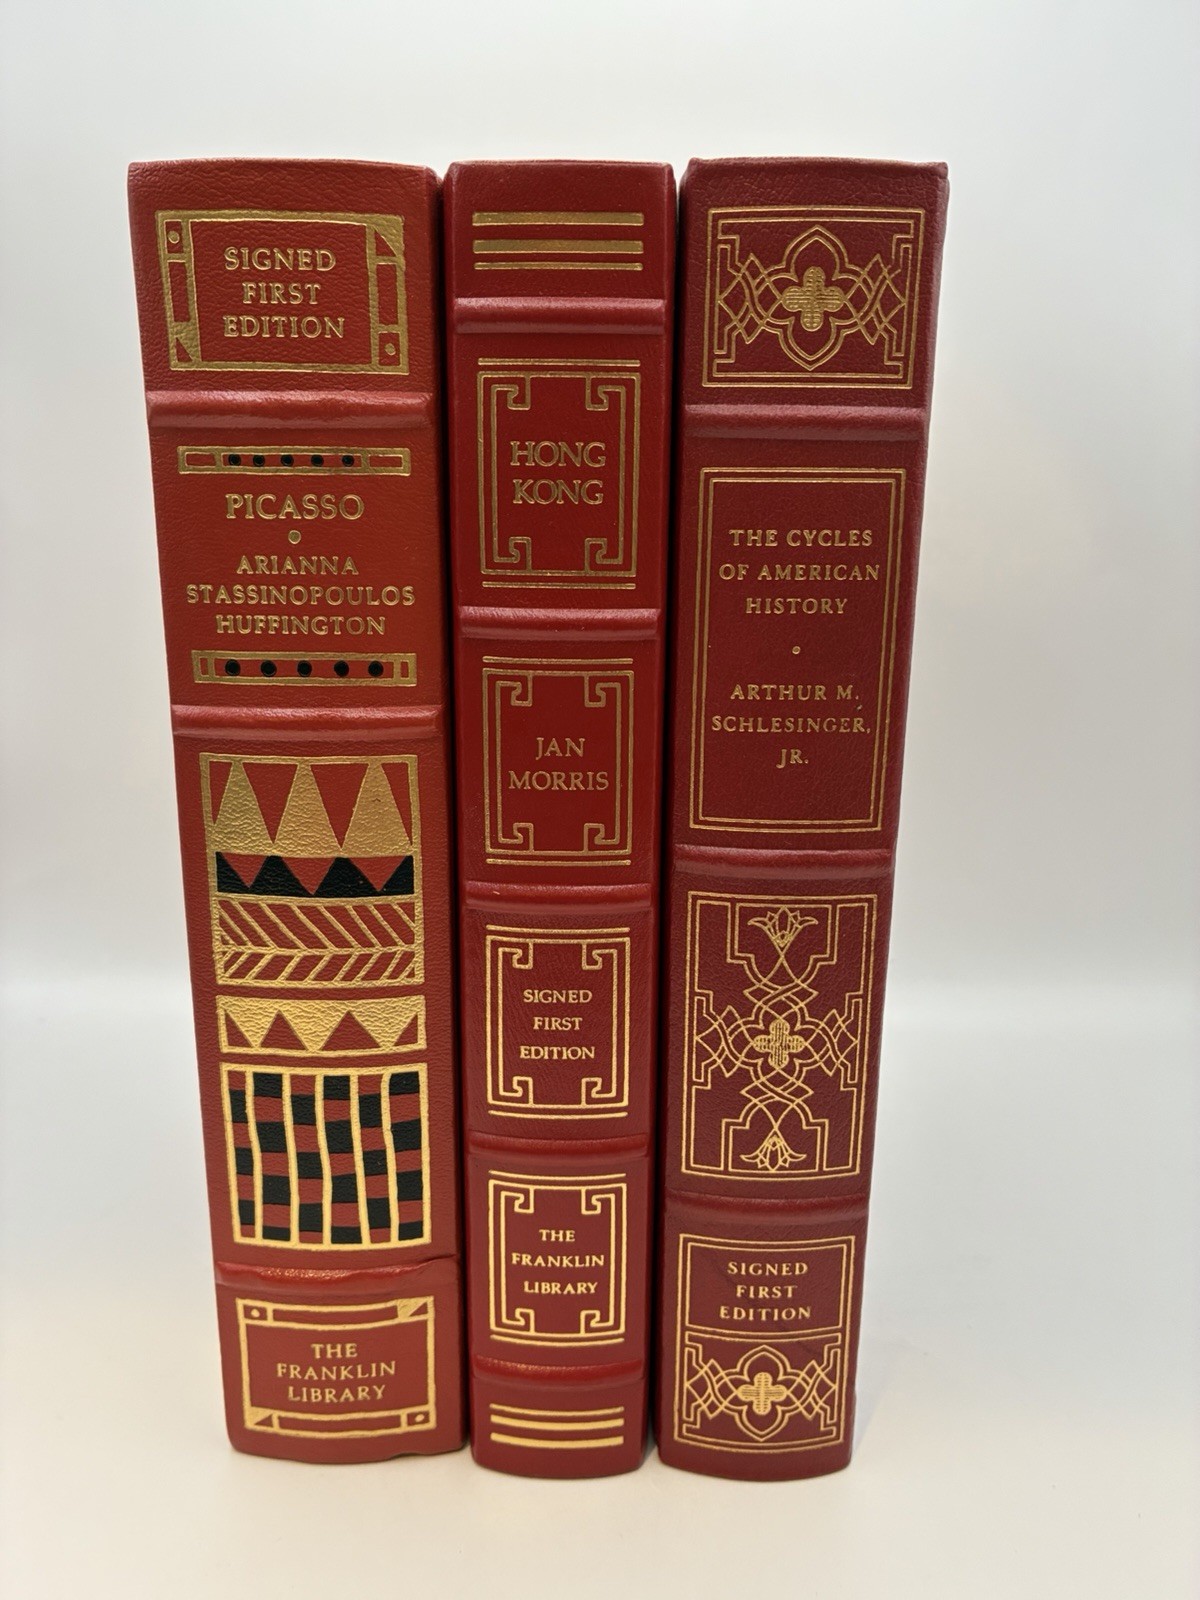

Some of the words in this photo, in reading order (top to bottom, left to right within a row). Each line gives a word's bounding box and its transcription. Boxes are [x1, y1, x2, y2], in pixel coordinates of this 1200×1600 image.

[224, 247, 336, 271] SIGNED
[242, 282, 321, 305] FIRST
[223, 315, 345, 338] EDITION
[510, 440, 606, 467] HONG
[512, 478, 604, 505] KONG
[225, 493, 365, 520] PICASSO
[728, 529, 778, 547] THE
[786, 529, 873, 547] CYCLES
[236, 555, 359, 575] ARIANNA
[718, 563, 749, 581] OF
[757, 564, 880, 581] AMERICAN
[186, 585, 416, 606] STASSINOPOULOS
[746, 597, 848, 614] HISTORY
[216, 614, 386, 635] HUFFINGTON
[730, 684, 827, 701] ARTHUR
[836, 684, 859, 701] M.
[711, 715, 871, 734] SCHLESINGER,
[535, 736, 586, 760] JAN
[776, 749, 809, 769] JR.
[508, 770, 609, 791] MORRIS
[523, 989, 593, 1004] SIGNED
[533, 1017, 583, 1031] FIRST
[519, 1046, 596, 1060] EDITION
[539, 1229, 576, 1242] THE
[511, 1252, 605, 1268] FRANKLIN
[727, 1261, 809, 1276] SIGNED
[523, 1280, 598, 1295] LIBRARY
[736, 1284, 798, 1299] FIRST
[719, 1305, 811, 1321] EDITION
[311, 1343, 358, 1359] THE
[276, 1360, 396, 1381] FRANKLIN
[287, 1384, 386, 1404] LIBRARY
